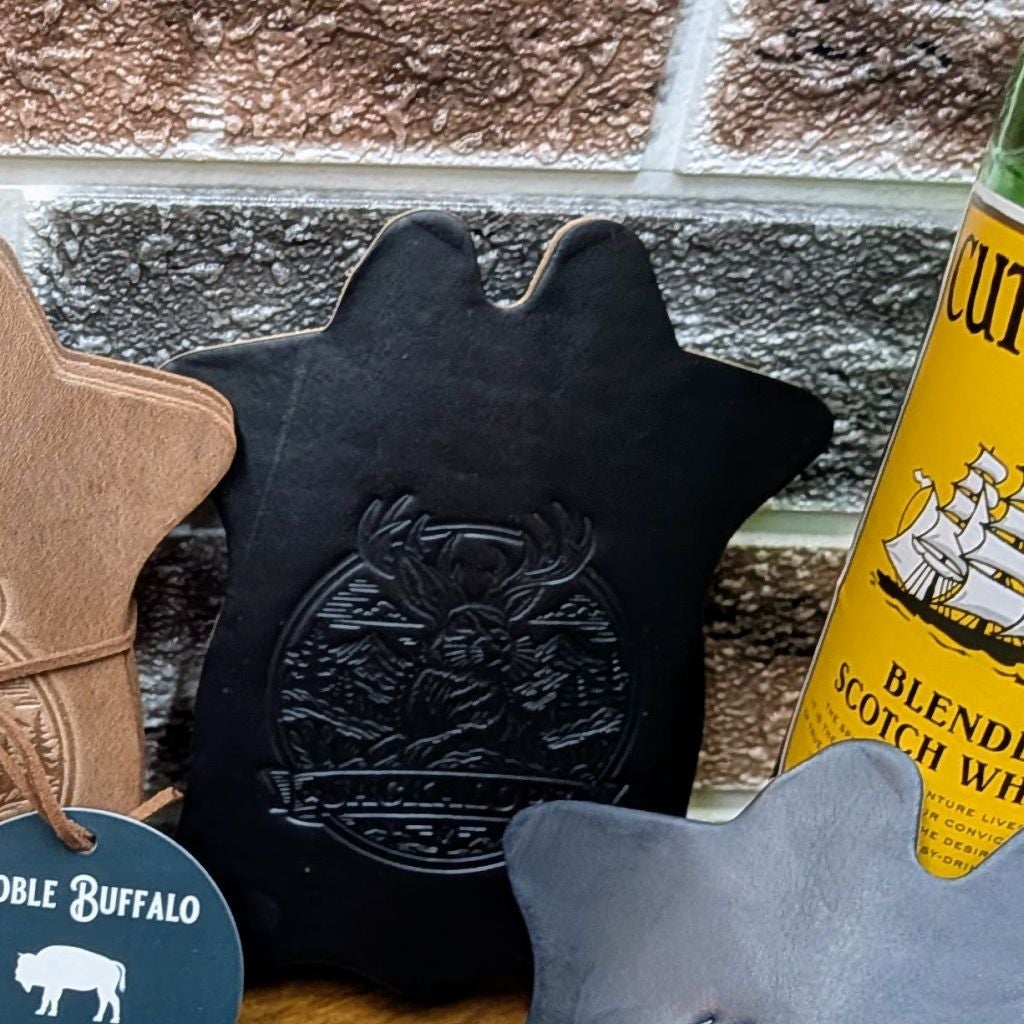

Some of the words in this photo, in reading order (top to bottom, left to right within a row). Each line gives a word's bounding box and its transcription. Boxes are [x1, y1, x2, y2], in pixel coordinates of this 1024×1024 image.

[834, 662, 948, 772] SCOTCH
[919, 845, 974, 871] BY-DRI
[69, 873, 201, 924] BUFFALO
